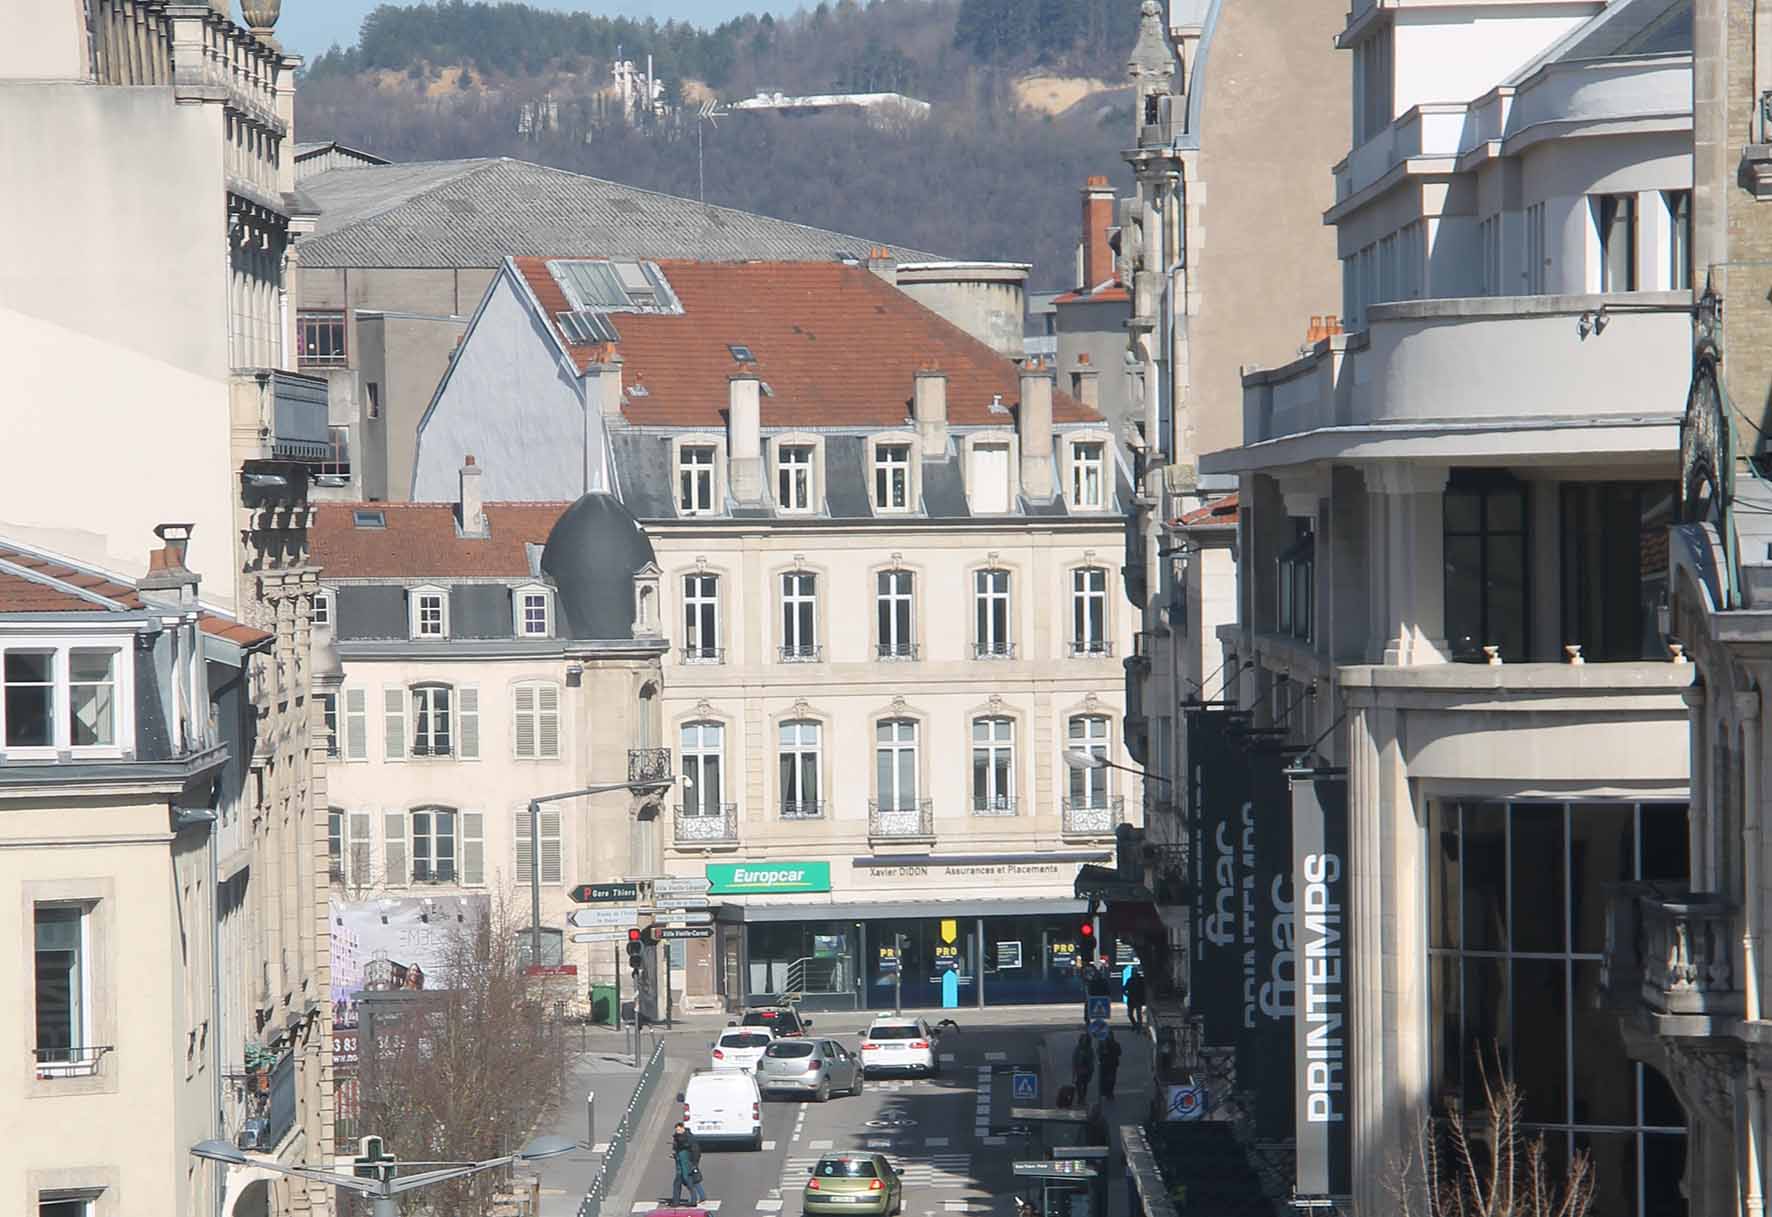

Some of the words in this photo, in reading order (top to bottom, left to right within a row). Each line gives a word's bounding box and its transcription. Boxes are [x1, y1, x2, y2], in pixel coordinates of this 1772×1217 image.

[870, 867, 897, 877] Xavier
[899, 867, 928, 877] DIDON
[945, 867, 995, 875] Assurances
[996, 866, 1005, 875] et
[1008, 864, 1058, 874] Placements
[733, 868, 805, 887] Europcar
[935, 946, 958, 957] PRO
[1053, 943, 1075, 953] PRO
[1258, 874, 1297, 1020] fnac
[1303, 853, 1343, 1123] PRINTEMPS
